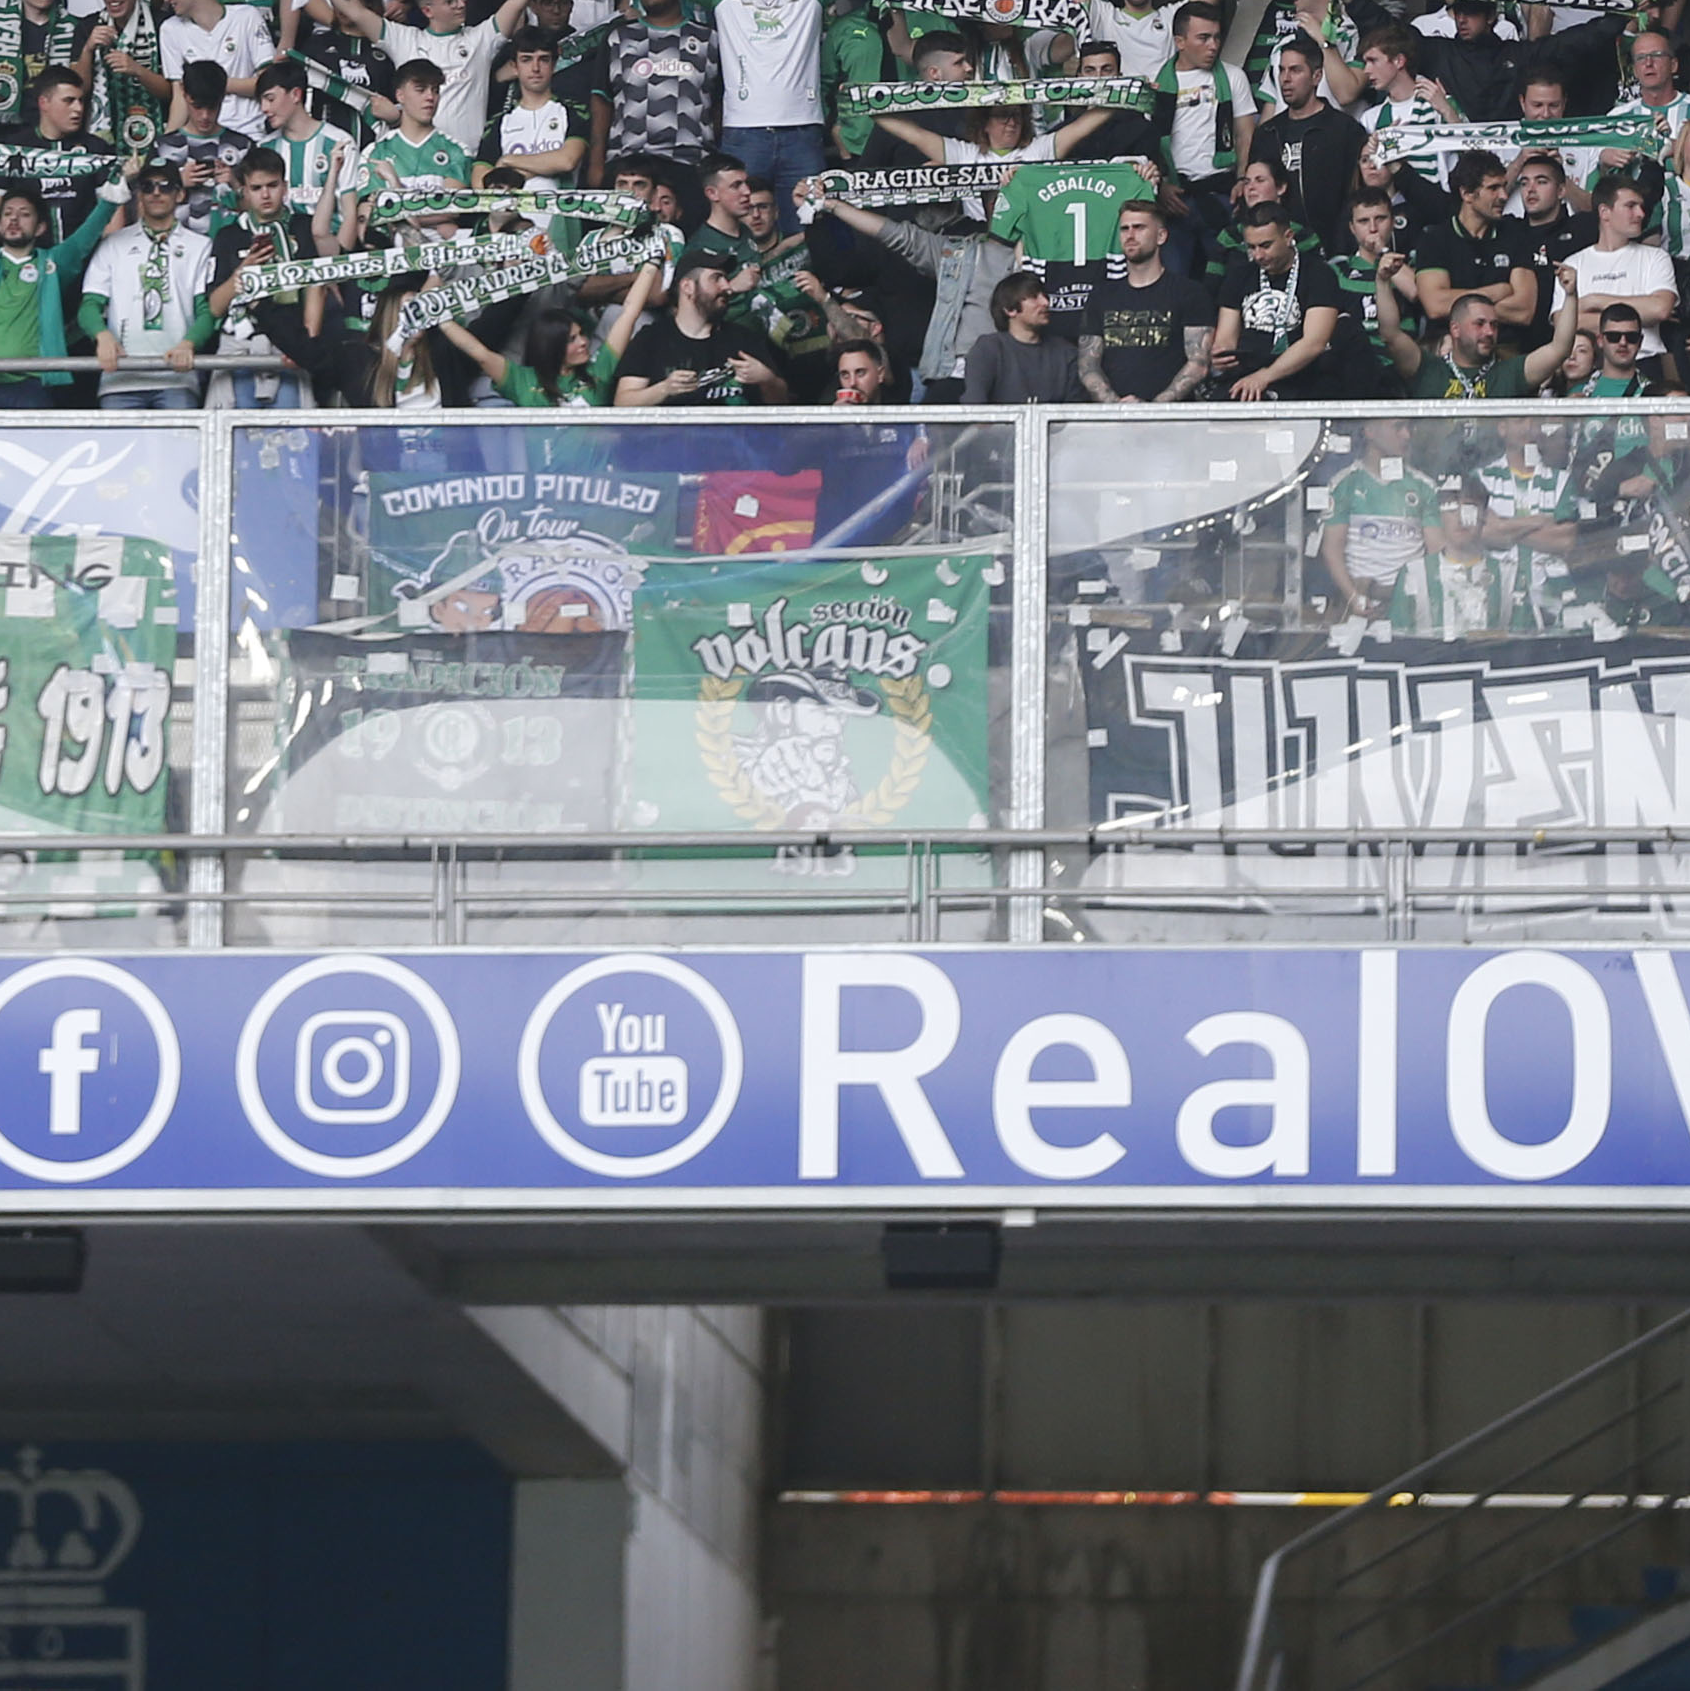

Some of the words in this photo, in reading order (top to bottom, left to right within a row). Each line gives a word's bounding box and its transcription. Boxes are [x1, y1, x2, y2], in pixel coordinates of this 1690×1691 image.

[652, 59, 694, 73] aldro
[849, 78, 970, 113] LOCOS
[1023, 79, 1096, 102] POR
[528, 139, 563, 152] aldro
[375, 190, 480, 218] OCOS
[533, 191, 608, 217] POR
[1037, 176, 1117, 203] CEBALLOS
[1064, 201, 1087, 268] 1
[239, 269, 277, 296] DE
[276, 254, 384, 288] PADRES
[386, 253, 412, 272] A
[419, 240, 501, 270] HIJOS
[425, 288, 459, 316] DE
[457, 257, 546, 300] PADRES
[548, 254, 571, 276] A
[575, 236, 647, 272] HIJOS
[1048, 294, 1088, 310] PAST
[380, 473, 526, 518] COMANDO
[534, 473, 661, 514] PITULEO
[476, 506, 519, 546] On
[521, 505, 580, 538] tour
[811, 593, 913, 630] sección
[596, 1001, 666, 1057] You
[592, 1067, 679, 1119] Tube
